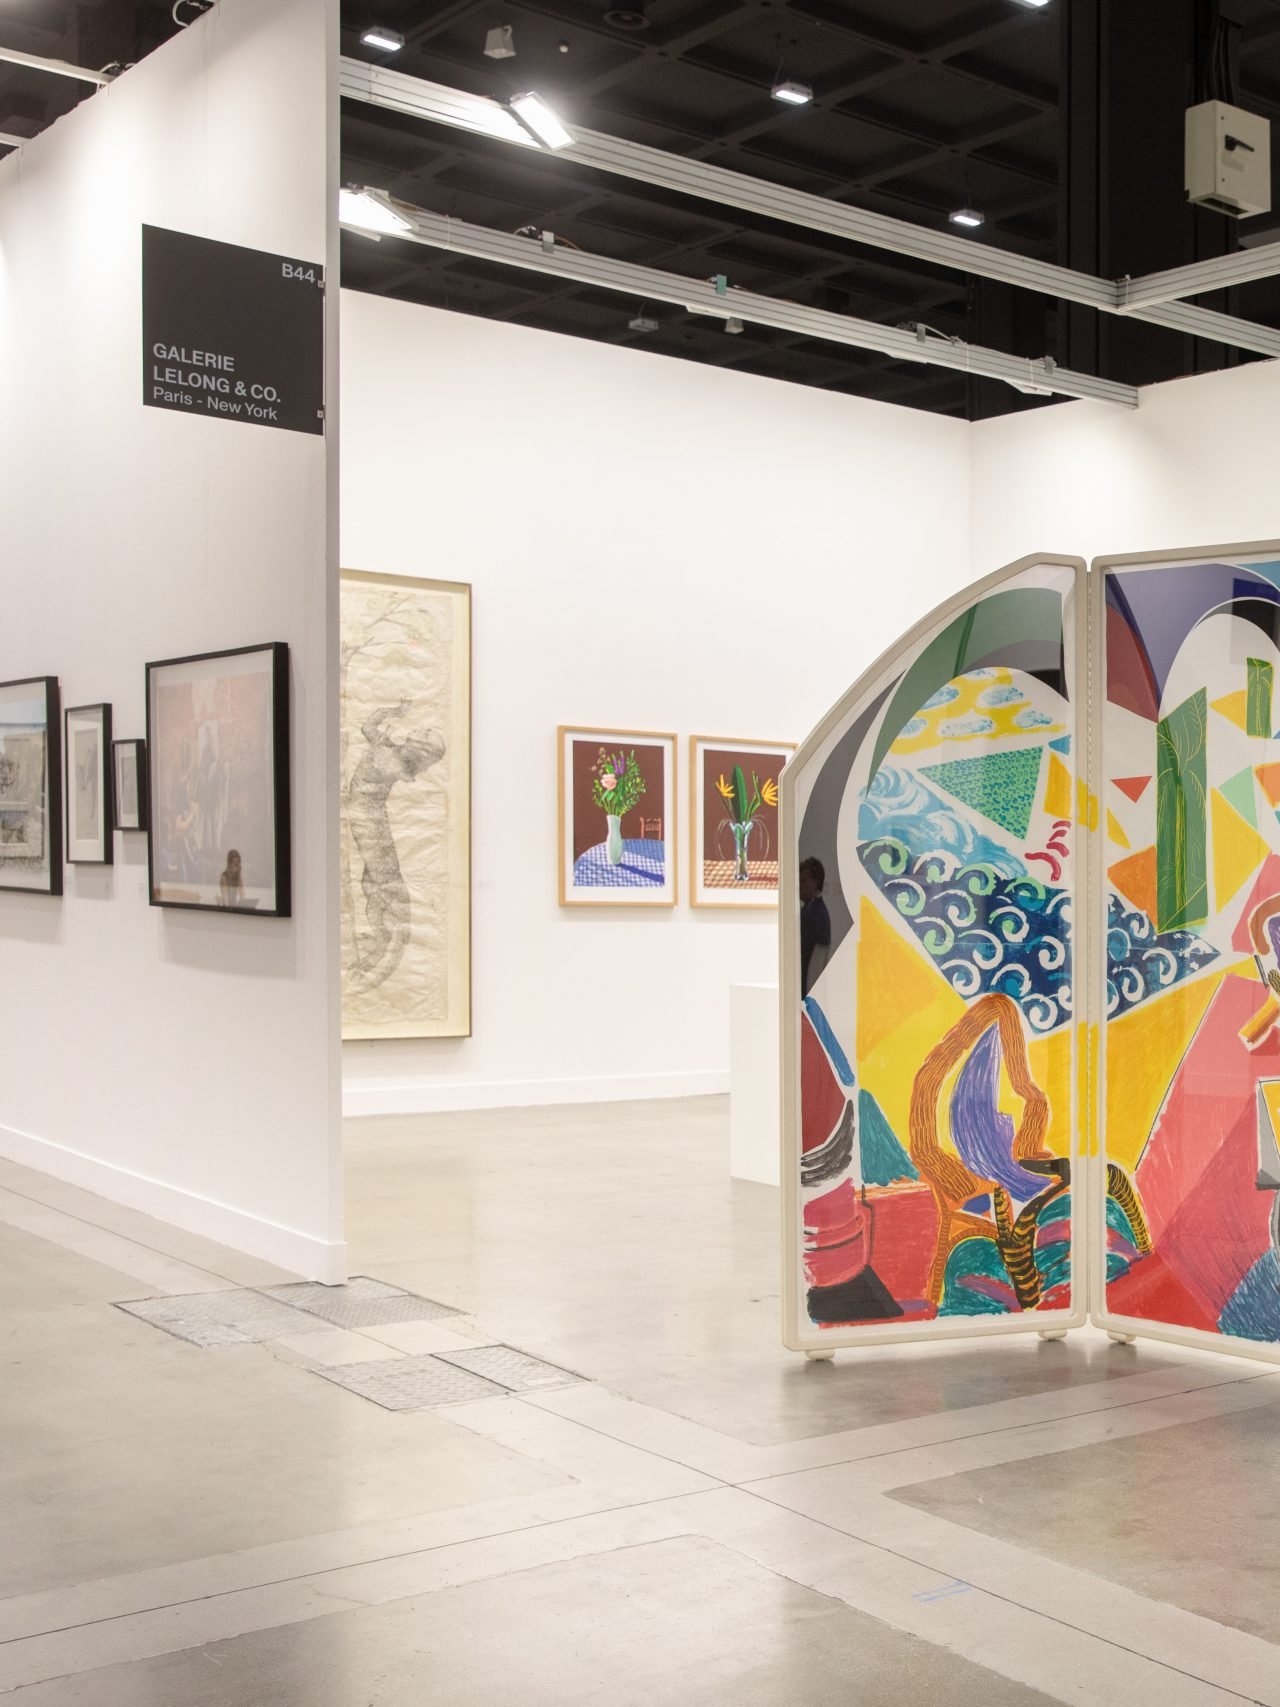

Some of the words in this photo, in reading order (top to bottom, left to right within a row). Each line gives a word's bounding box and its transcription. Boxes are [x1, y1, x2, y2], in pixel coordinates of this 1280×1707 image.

[281, 263, 315, 283] B44
[153, 343, 235, 372] GALERIE
[154, 366, 229, 393] LELONG
[234, 380, 247, 396] &
[250, 384, 281, 403] CO.
[153, 386, 193, 405] Paris
[207, 396, 242, 413] New
[244, 402, 278, 420] York
